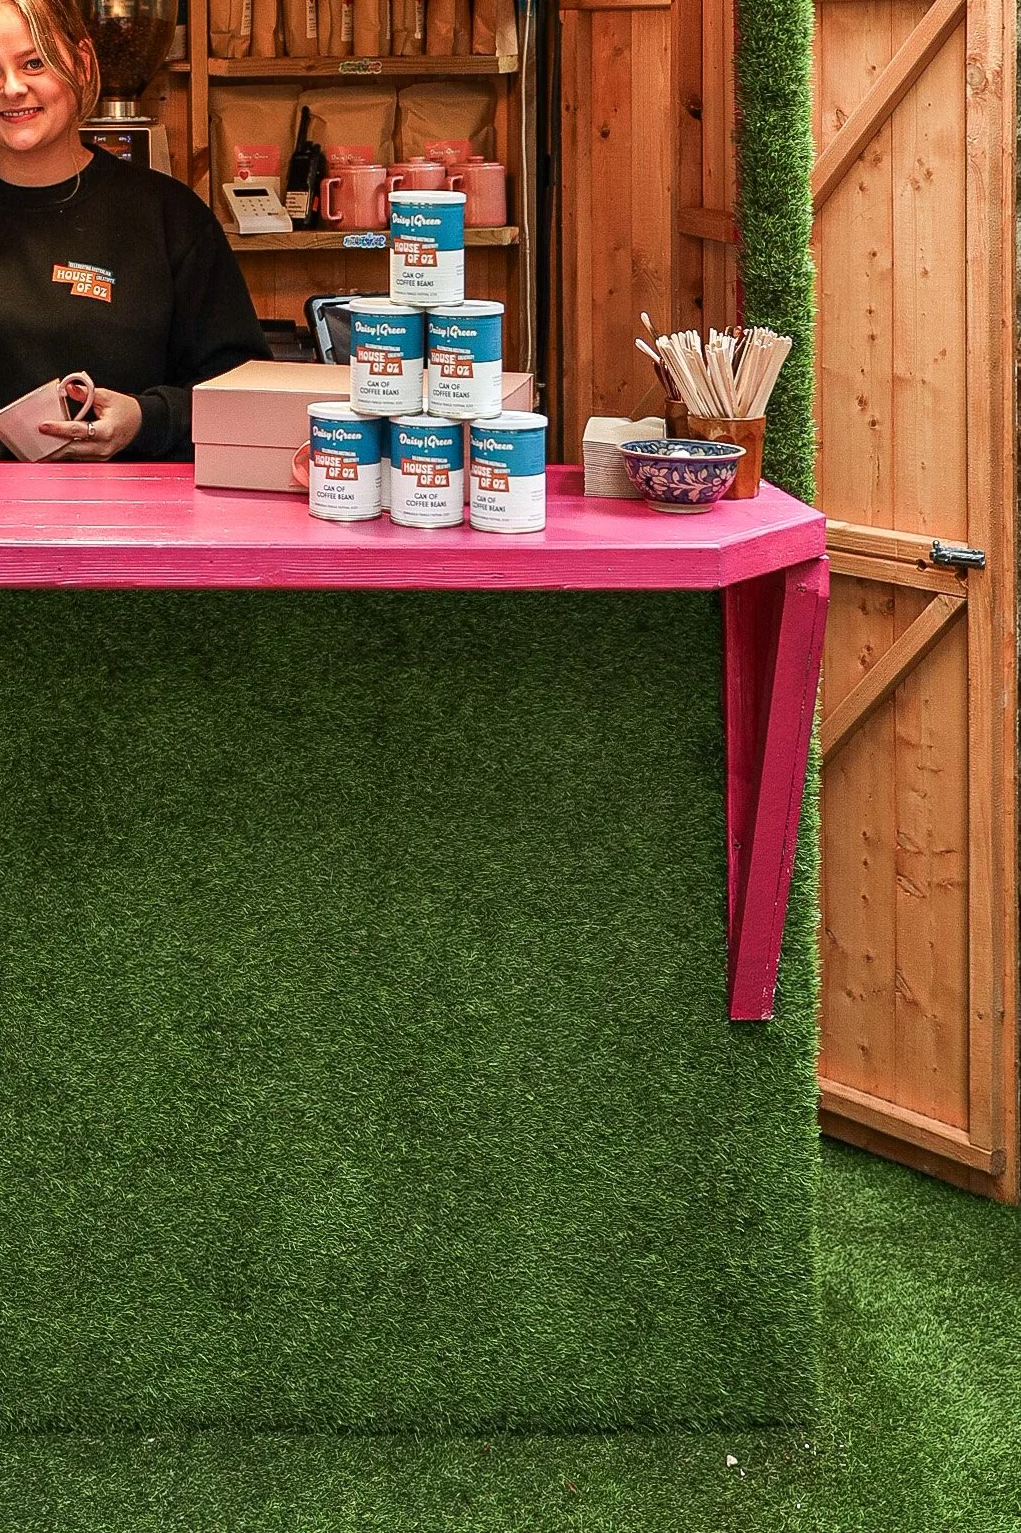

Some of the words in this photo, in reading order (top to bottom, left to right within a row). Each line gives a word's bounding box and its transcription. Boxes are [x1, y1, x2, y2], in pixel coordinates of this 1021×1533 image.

[392, 213, 410, 226] Daisy
[414, 215, 441, 227] Green
[395, 243, 420, 253] HOUSE
[408, 254, 419, 263] OF
[421, 255, 433, 264] OZ
[57, 270, 93, 283] HOUSE
[77, 283, 92, 293] OF
[93, 286, 107, 297] OZ
[355, 322, 376, 335] Daisy
[380, 324, 406, 336] Green
[429, 323, 446, 337] Daisy
[450, 326, 477, 338] Green
[358, 351, 385, 362] HOUSE
[431, 353, 455, 364] HOUSE
[373, 363, 385, 372] OF
[387, 364, 399, 372] OZ
[444, 365, 455, 374] OF
[457, 366, 469, 375] OZ
[313, 426, 332, 440] Daisy
[336, 429, 362, 441] Green
[399, 433, 423, 448] Daisy
[428, 436, 452, 448] Green
[487, 439, 513, 451] Green
[316, 455, 341, 466] HOUSE
[329, 468, 341, 477] OF
[343, 469, 354, 478] OZ
[404, 463, 434, 474] HOUSE
[421, 475, 434, 485] OF
[435, 475, 447, 485] OZ
[481, 478, 491, 487] OF
[493, 479, 505, 489] OZ
[317, 491, 336, 499] COFFEE
